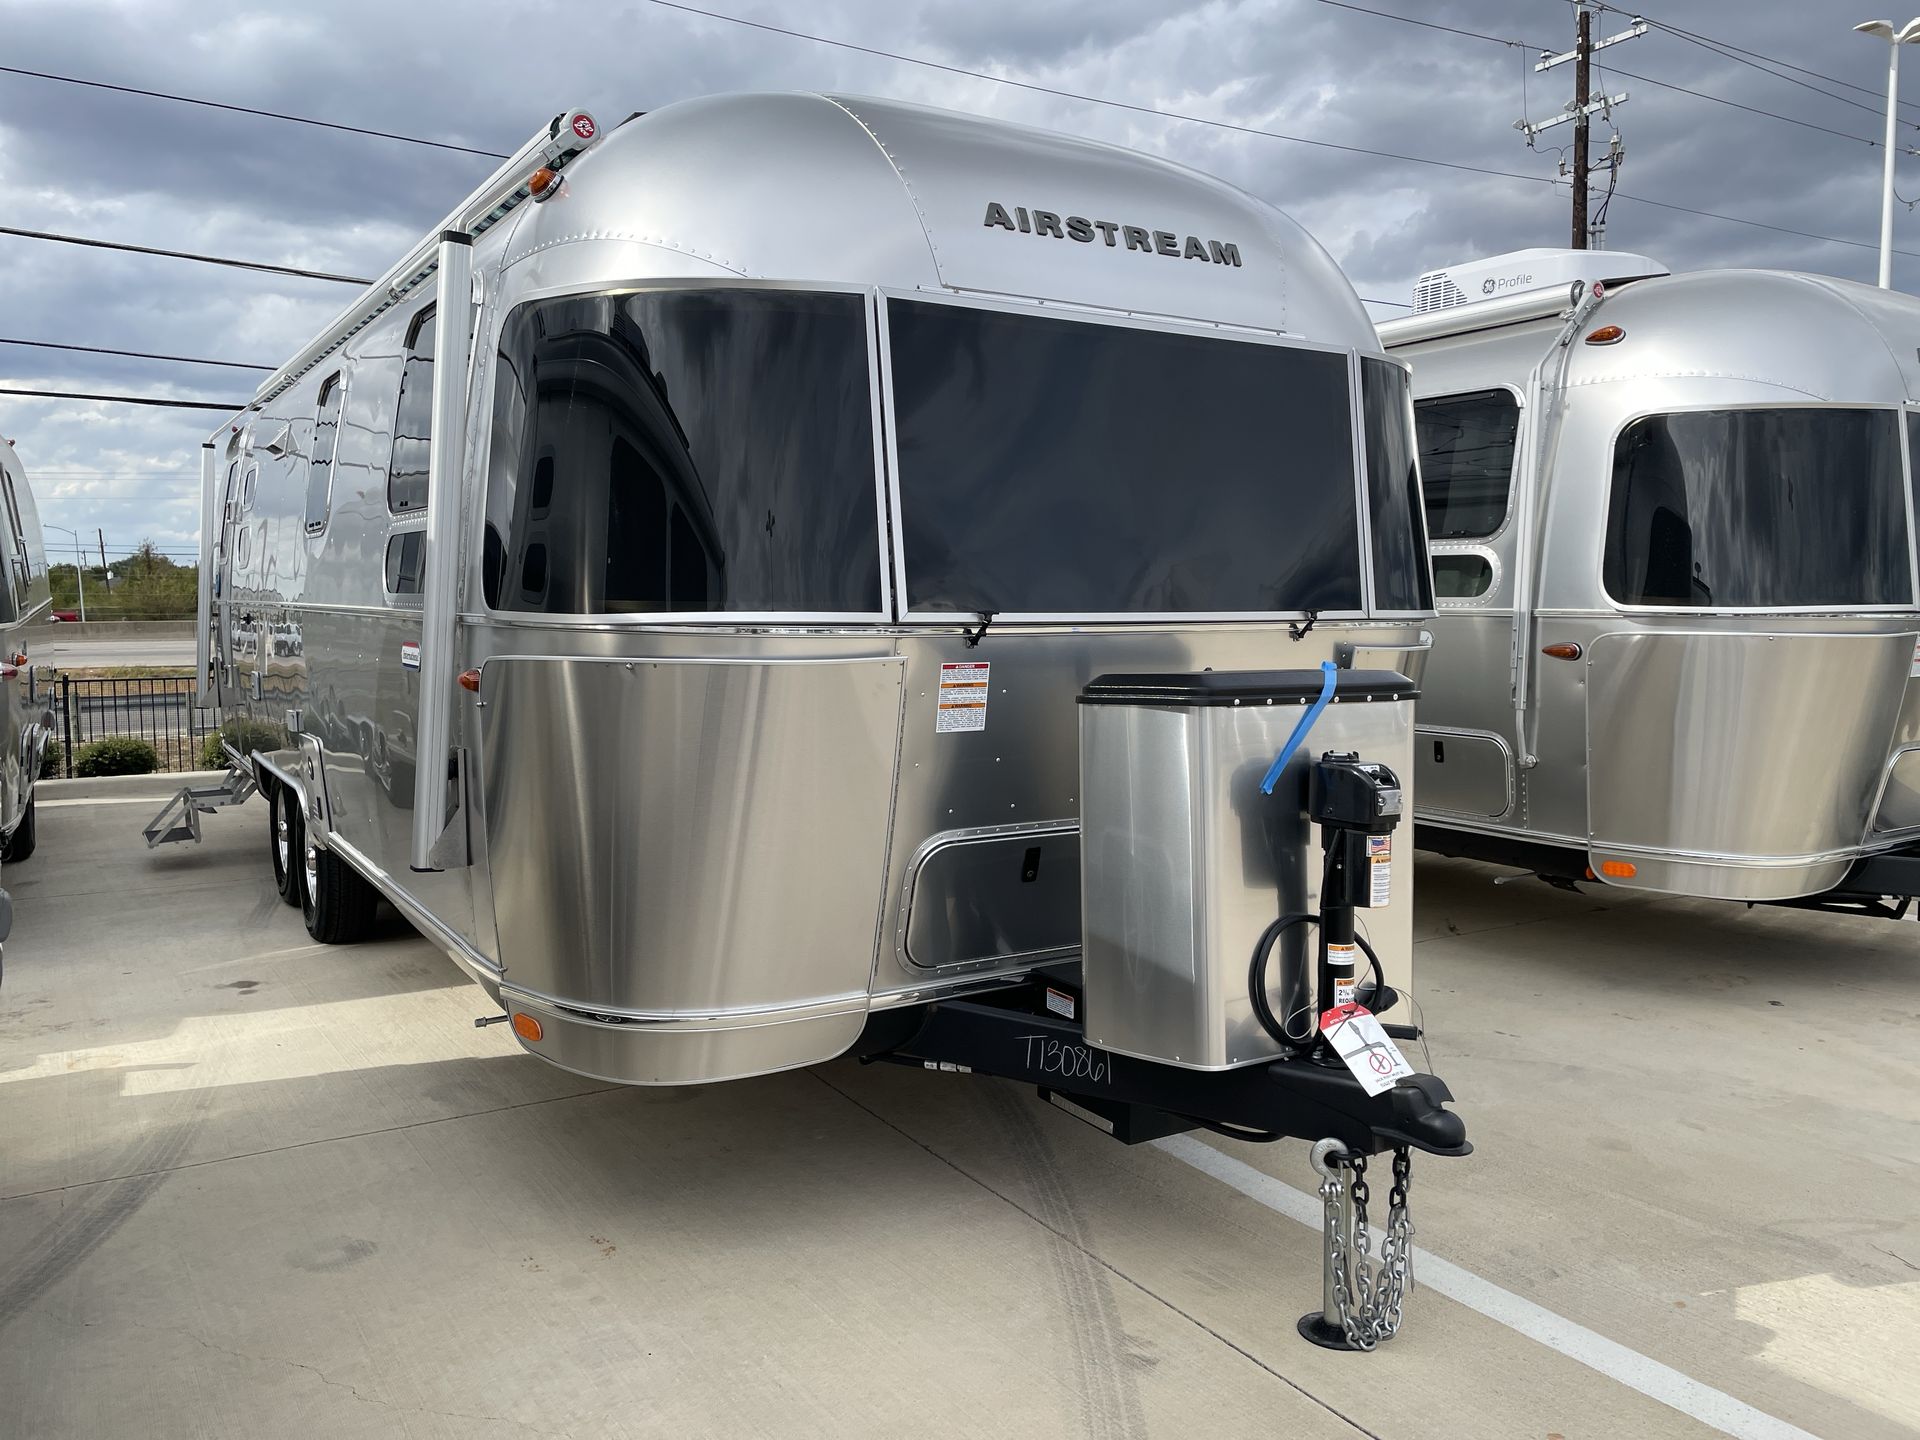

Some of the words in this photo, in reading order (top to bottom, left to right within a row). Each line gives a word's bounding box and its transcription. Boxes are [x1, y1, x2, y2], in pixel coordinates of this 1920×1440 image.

[984, 202, 1242, 267] AIRSTREAM
[1498, 274, 1532, 289] Profile
[1014, 1034, 1112, 1086] T130861
